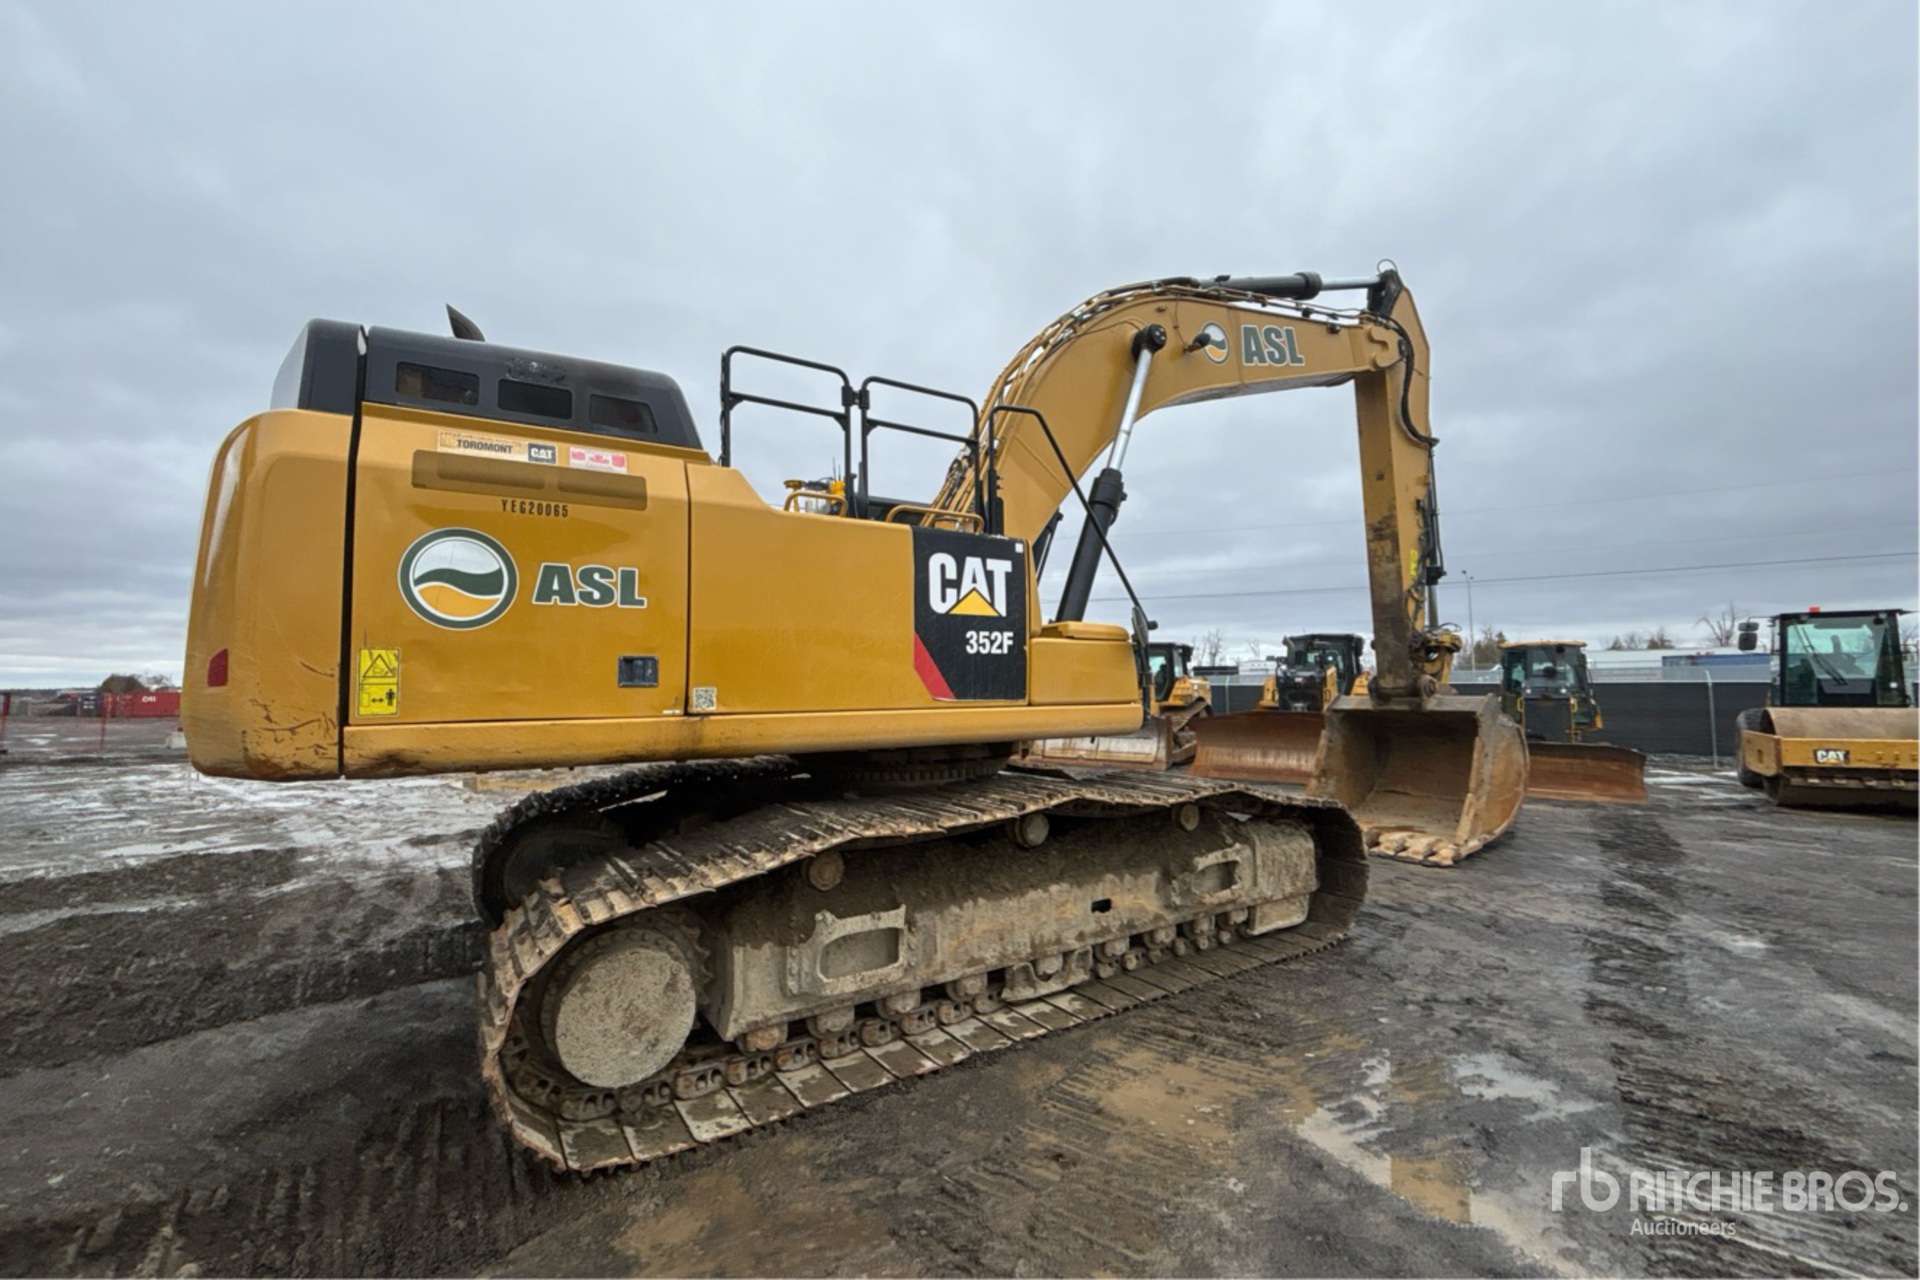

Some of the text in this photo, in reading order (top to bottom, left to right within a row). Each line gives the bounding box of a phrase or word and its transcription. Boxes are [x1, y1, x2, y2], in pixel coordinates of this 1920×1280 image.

[1242, 325, 1305, 366] ASL
[457, 439, 513, 454] TOROMONT
[530, 447, 554, 460] CAT
[501, 499, 569, 518] YEG20065
[532, 563, 647, 609] ASL
[928, 552, 1013, 617] CAT
[965, 630, 1014, 654] 352F
[1816, 750, 1847, 763] CAT
